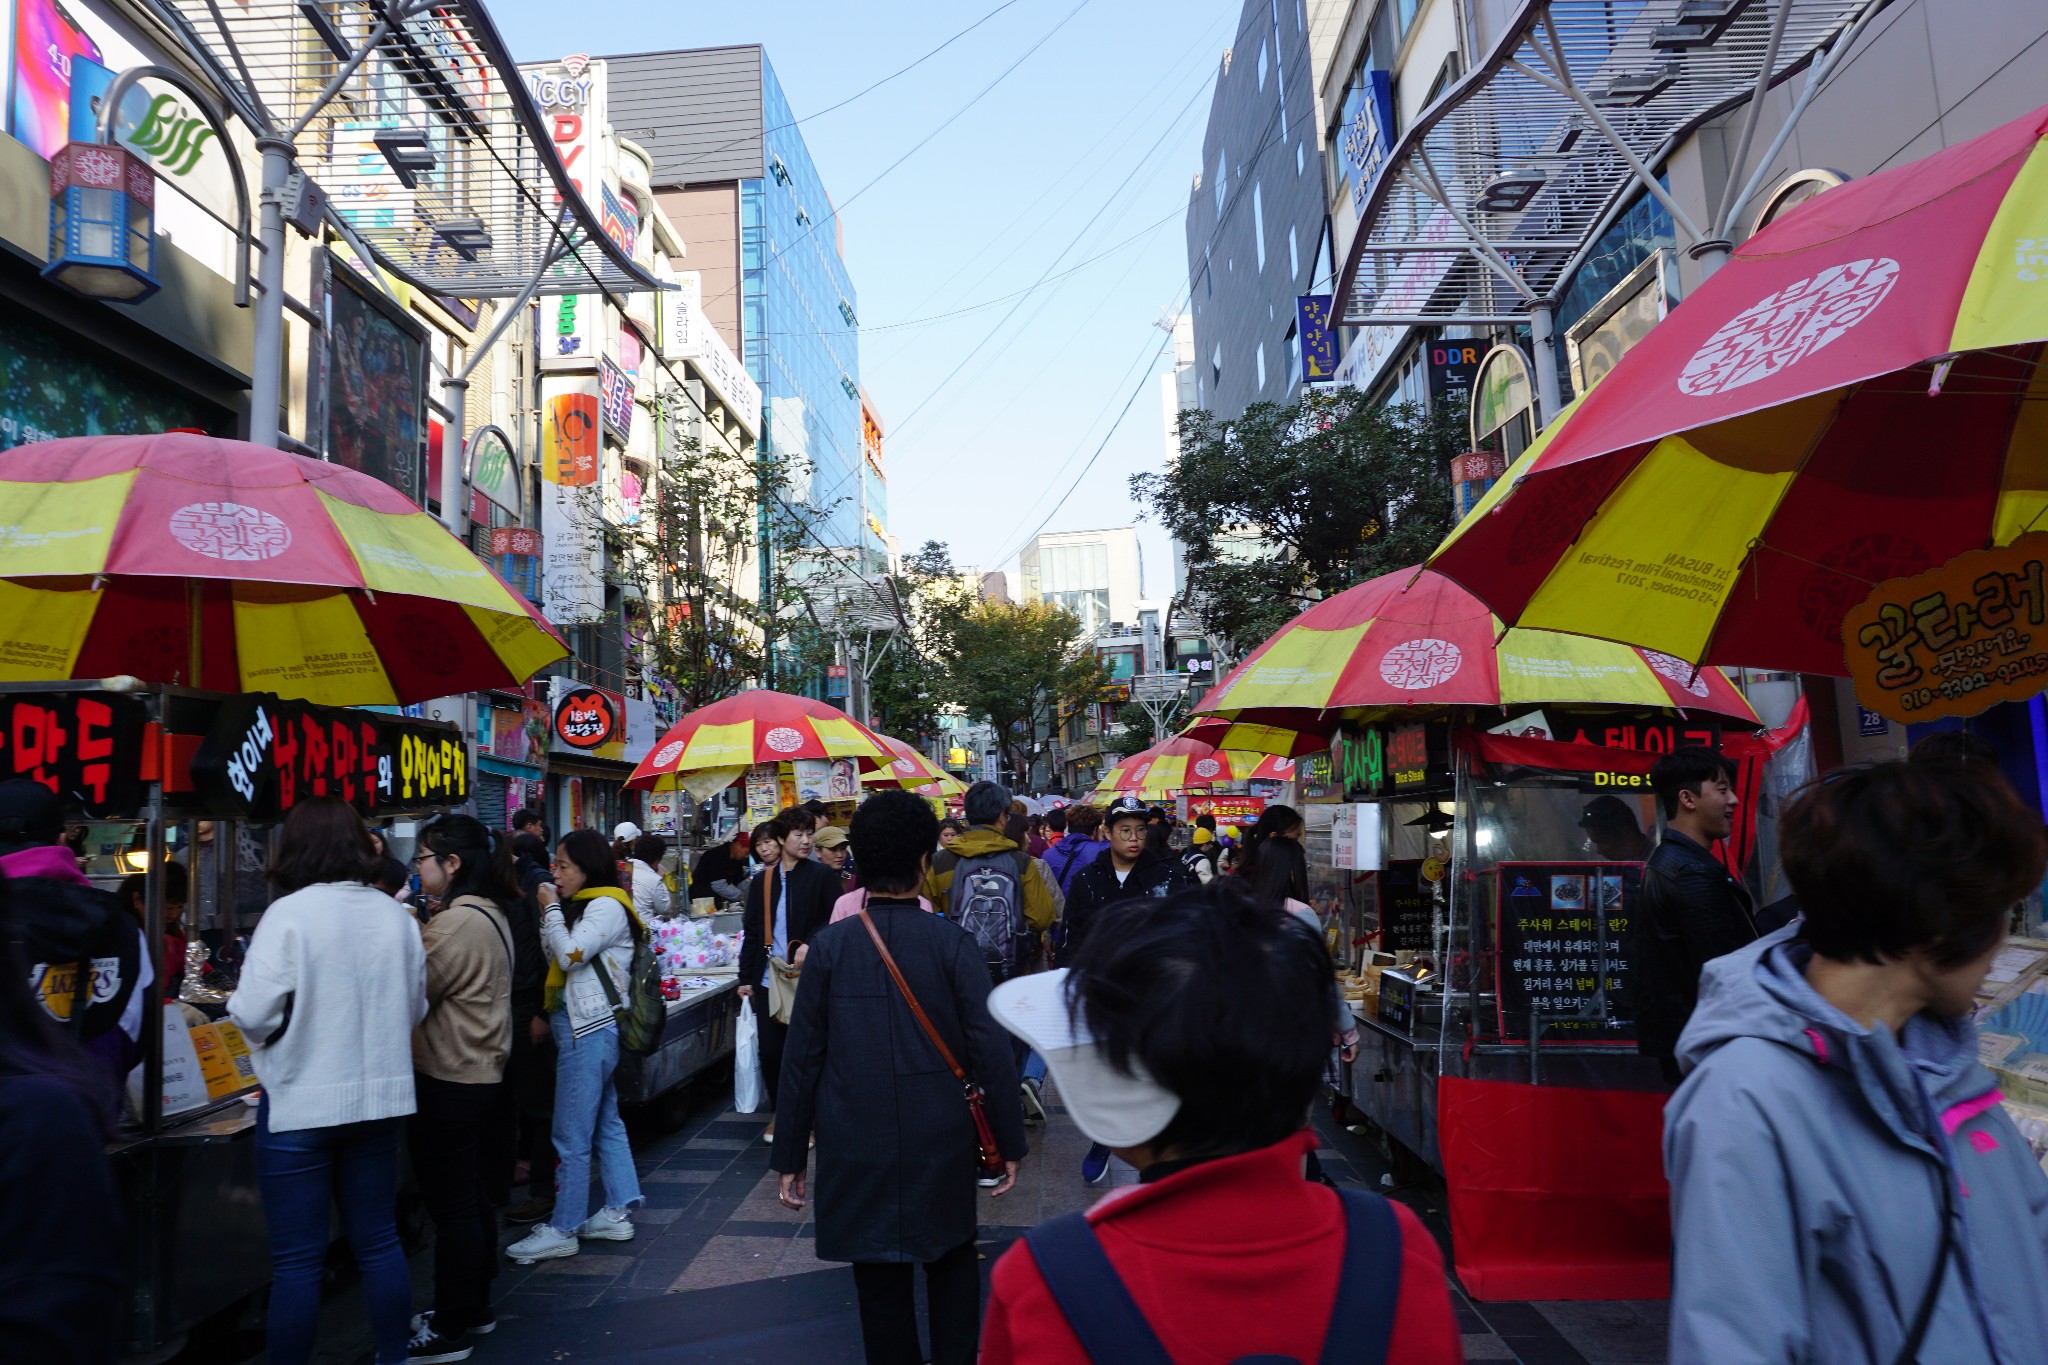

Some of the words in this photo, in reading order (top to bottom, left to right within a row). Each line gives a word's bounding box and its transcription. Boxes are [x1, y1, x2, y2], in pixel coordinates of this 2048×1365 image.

[672, 302, 690, 344] 슬라임
[557, 337, 581, 355] 3F
[1433, 347, 1477, 365] DDR
[1446, 369, 1468, 422] 노래
[1859, 560, 2046, 690] 꿀타래
[1937, 627, 2026, 679] 맛있어요
[1901, 688, 1933, 711] 010
[1939, 671, 1989, 700] 3302
[570, 709, 599, 721] 18번
[1863, 712, 1881, 726] 28
[563, 723, 605, 736] 완당집
[0, 698, 113, 804] 만두
[401, 733, 466, 799] 오징어무침
[1343, 729, 1383, 792] 주사위
[1388, 731, 1425, 768] 스테이크
[1395, 771, 1408, 784] Dice
[1408, 769, 1425, 783] Steak
[1594, 771, 1642, 787] Dice
[1517, 918, 1552, 932] 주사위
[1608, 918, 1629, 932] 란?
[1523, 940, 1561, 953] 대만에서
[1512, 959, 1533, 972] 현재
[1559, 959, 1589, 972] 싱가폴
[35, 966, 115, 998] LAKRS
[1523, 978, 1552, 991] 길거리
[1553, 978, 1574, 991] 음식
